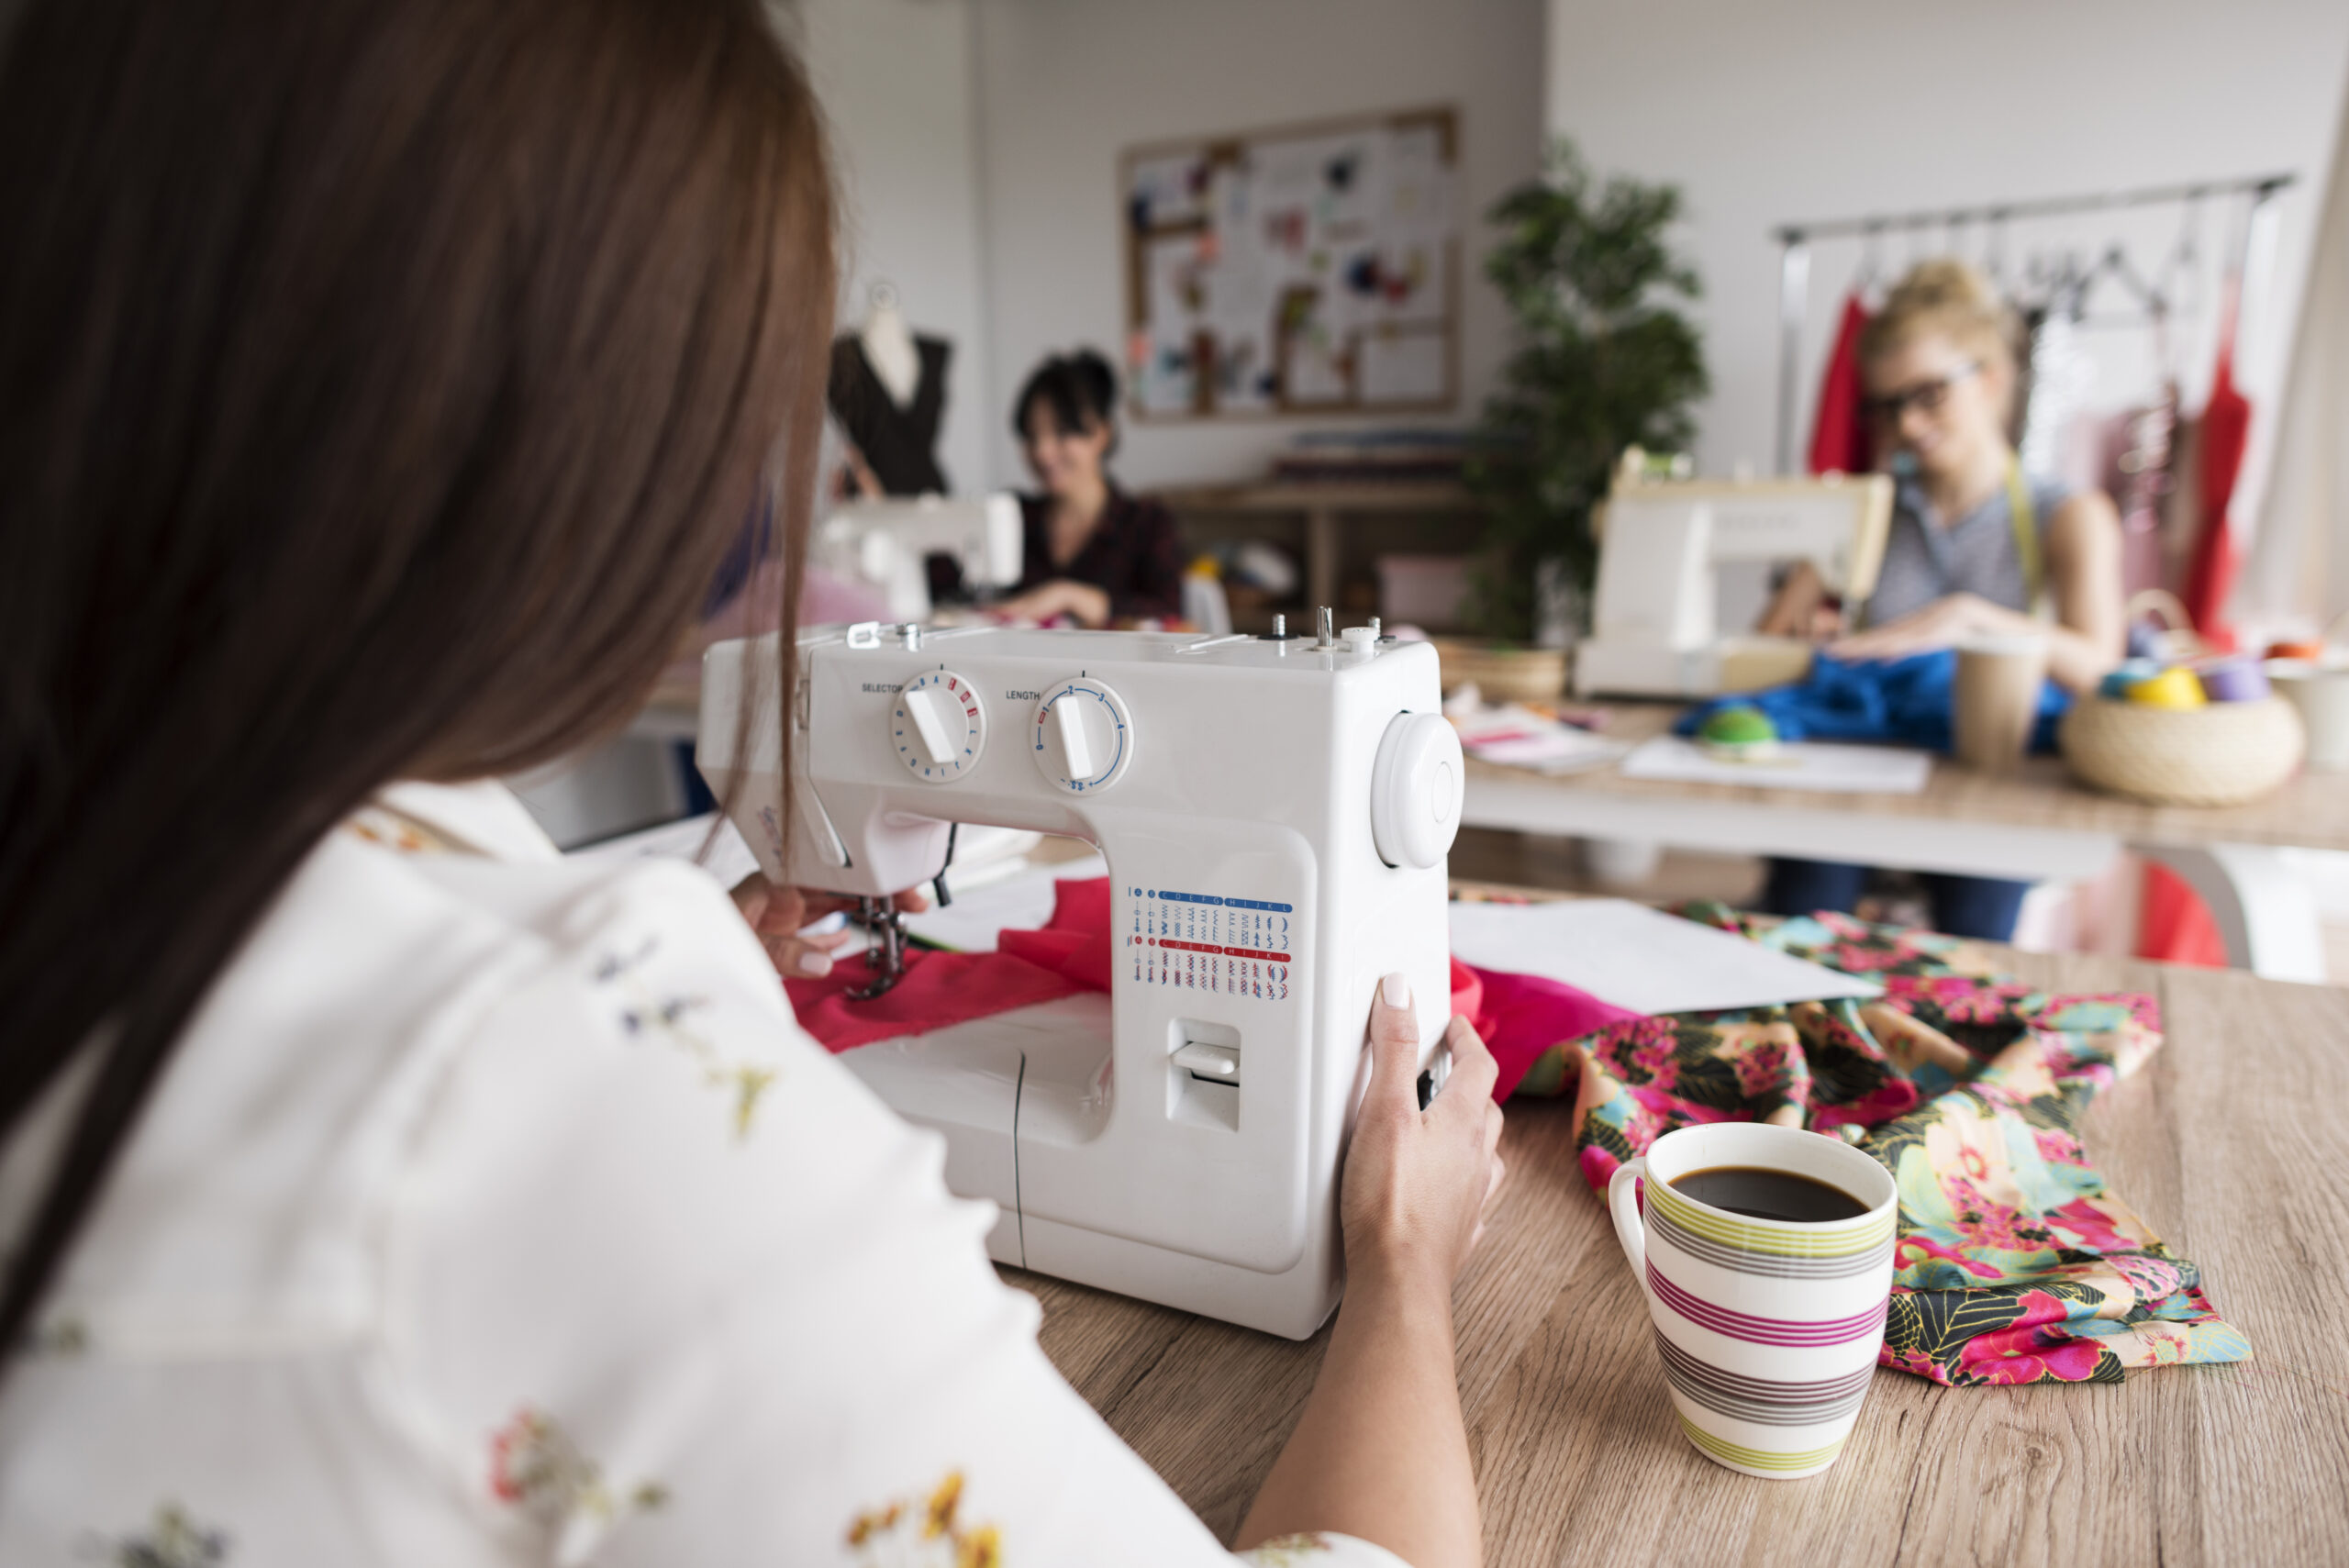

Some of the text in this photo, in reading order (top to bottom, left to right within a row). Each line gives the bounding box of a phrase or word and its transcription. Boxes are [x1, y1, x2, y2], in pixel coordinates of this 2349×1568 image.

[1006, 690, 1040, 700] LENGTH
[1068, 685, 1074, 694] 2
[1098, 693, 1105, 702] 3
